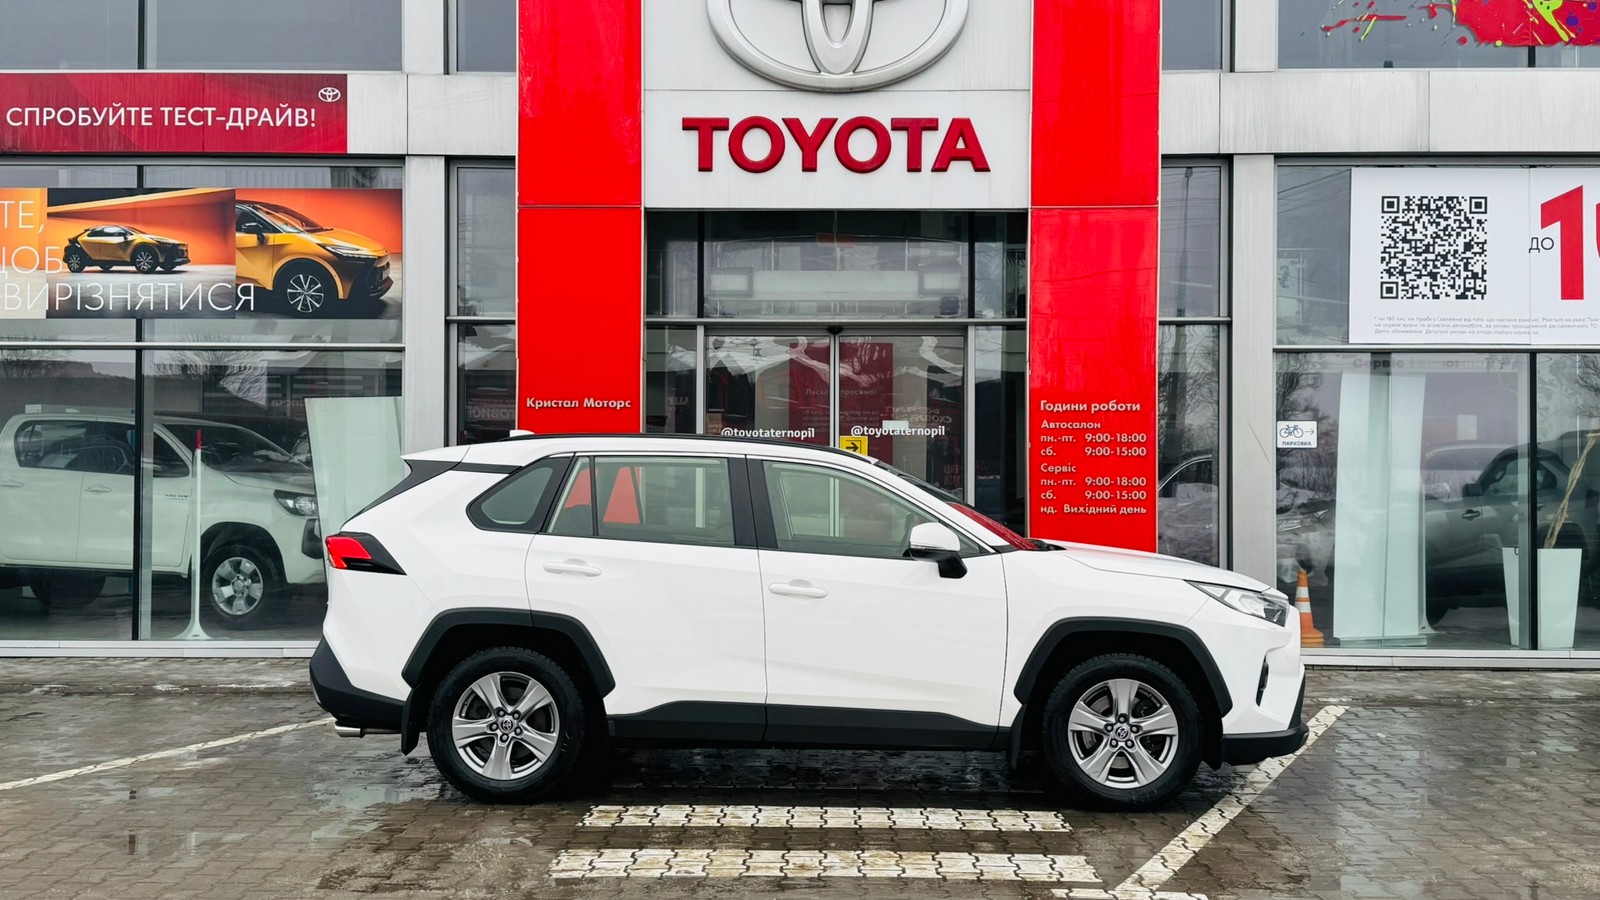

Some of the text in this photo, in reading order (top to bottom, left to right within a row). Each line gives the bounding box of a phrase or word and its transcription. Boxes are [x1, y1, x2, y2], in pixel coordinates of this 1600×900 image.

[6, 102, 316, 131] СПРОБУЙТЕ ТЕСТ-ДРАЙВ!
[682, 115, 991, 174] TOYOTA
[0, 246, 63, 280] ОБ
[4, 282, 255, 312] ВИРІЗНЯТИСЯ
[526, 397, 579, 410] Кристал
[583, 397, 632, 410] Моторс
[1040, 399, 1141, 414] Години роботи
[1041, 419, 1101, 429] Автосалон
[721, 427, 815, 440] @toyotaternopil
[851, 425, 945, 438] @toyotaternopil
[1040, 433, 1147, 443] пн.-пт. 9:00-18:00
[1040, 446, 1147, 456] сб. 9:00-15:00
[1041, 462, 1077, 474] Сервіс
[1040, 476, 1147, 486] пн.-пт. 9:00-18:00
[1040, 489, 1147, 500] сб. 9:00-15:00
[1040, 503, 1147, 514] нд. Вихідний день
